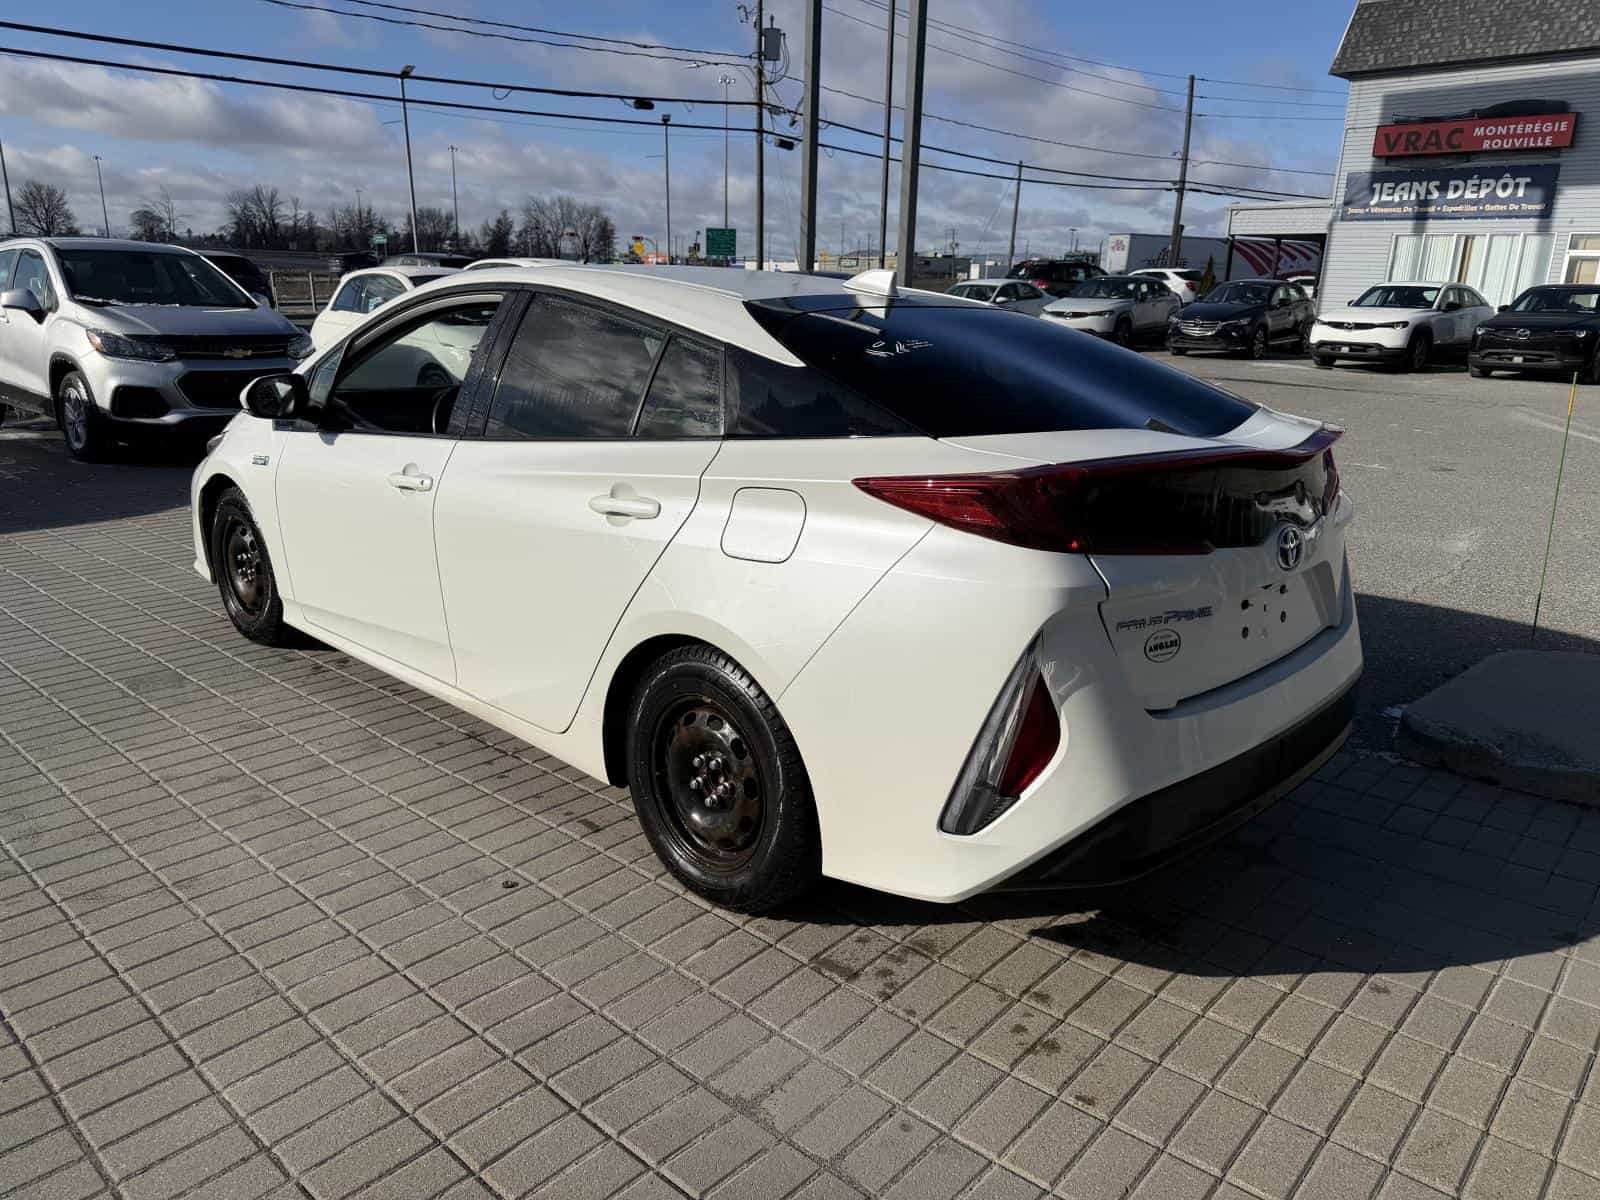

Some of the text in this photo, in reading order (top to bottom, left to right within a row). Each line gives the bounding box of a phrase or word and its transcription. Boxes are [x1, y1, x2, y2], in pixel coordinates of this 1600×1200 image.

[1473, 121, 1569, 136] MONTÉRÉGIE
[1384, 128, 1464, 152] VRAC
[1482, 136, 1553, 149] ROUVILLE
[1370, 173, 1531, 205] JEANS DÉPÔT
